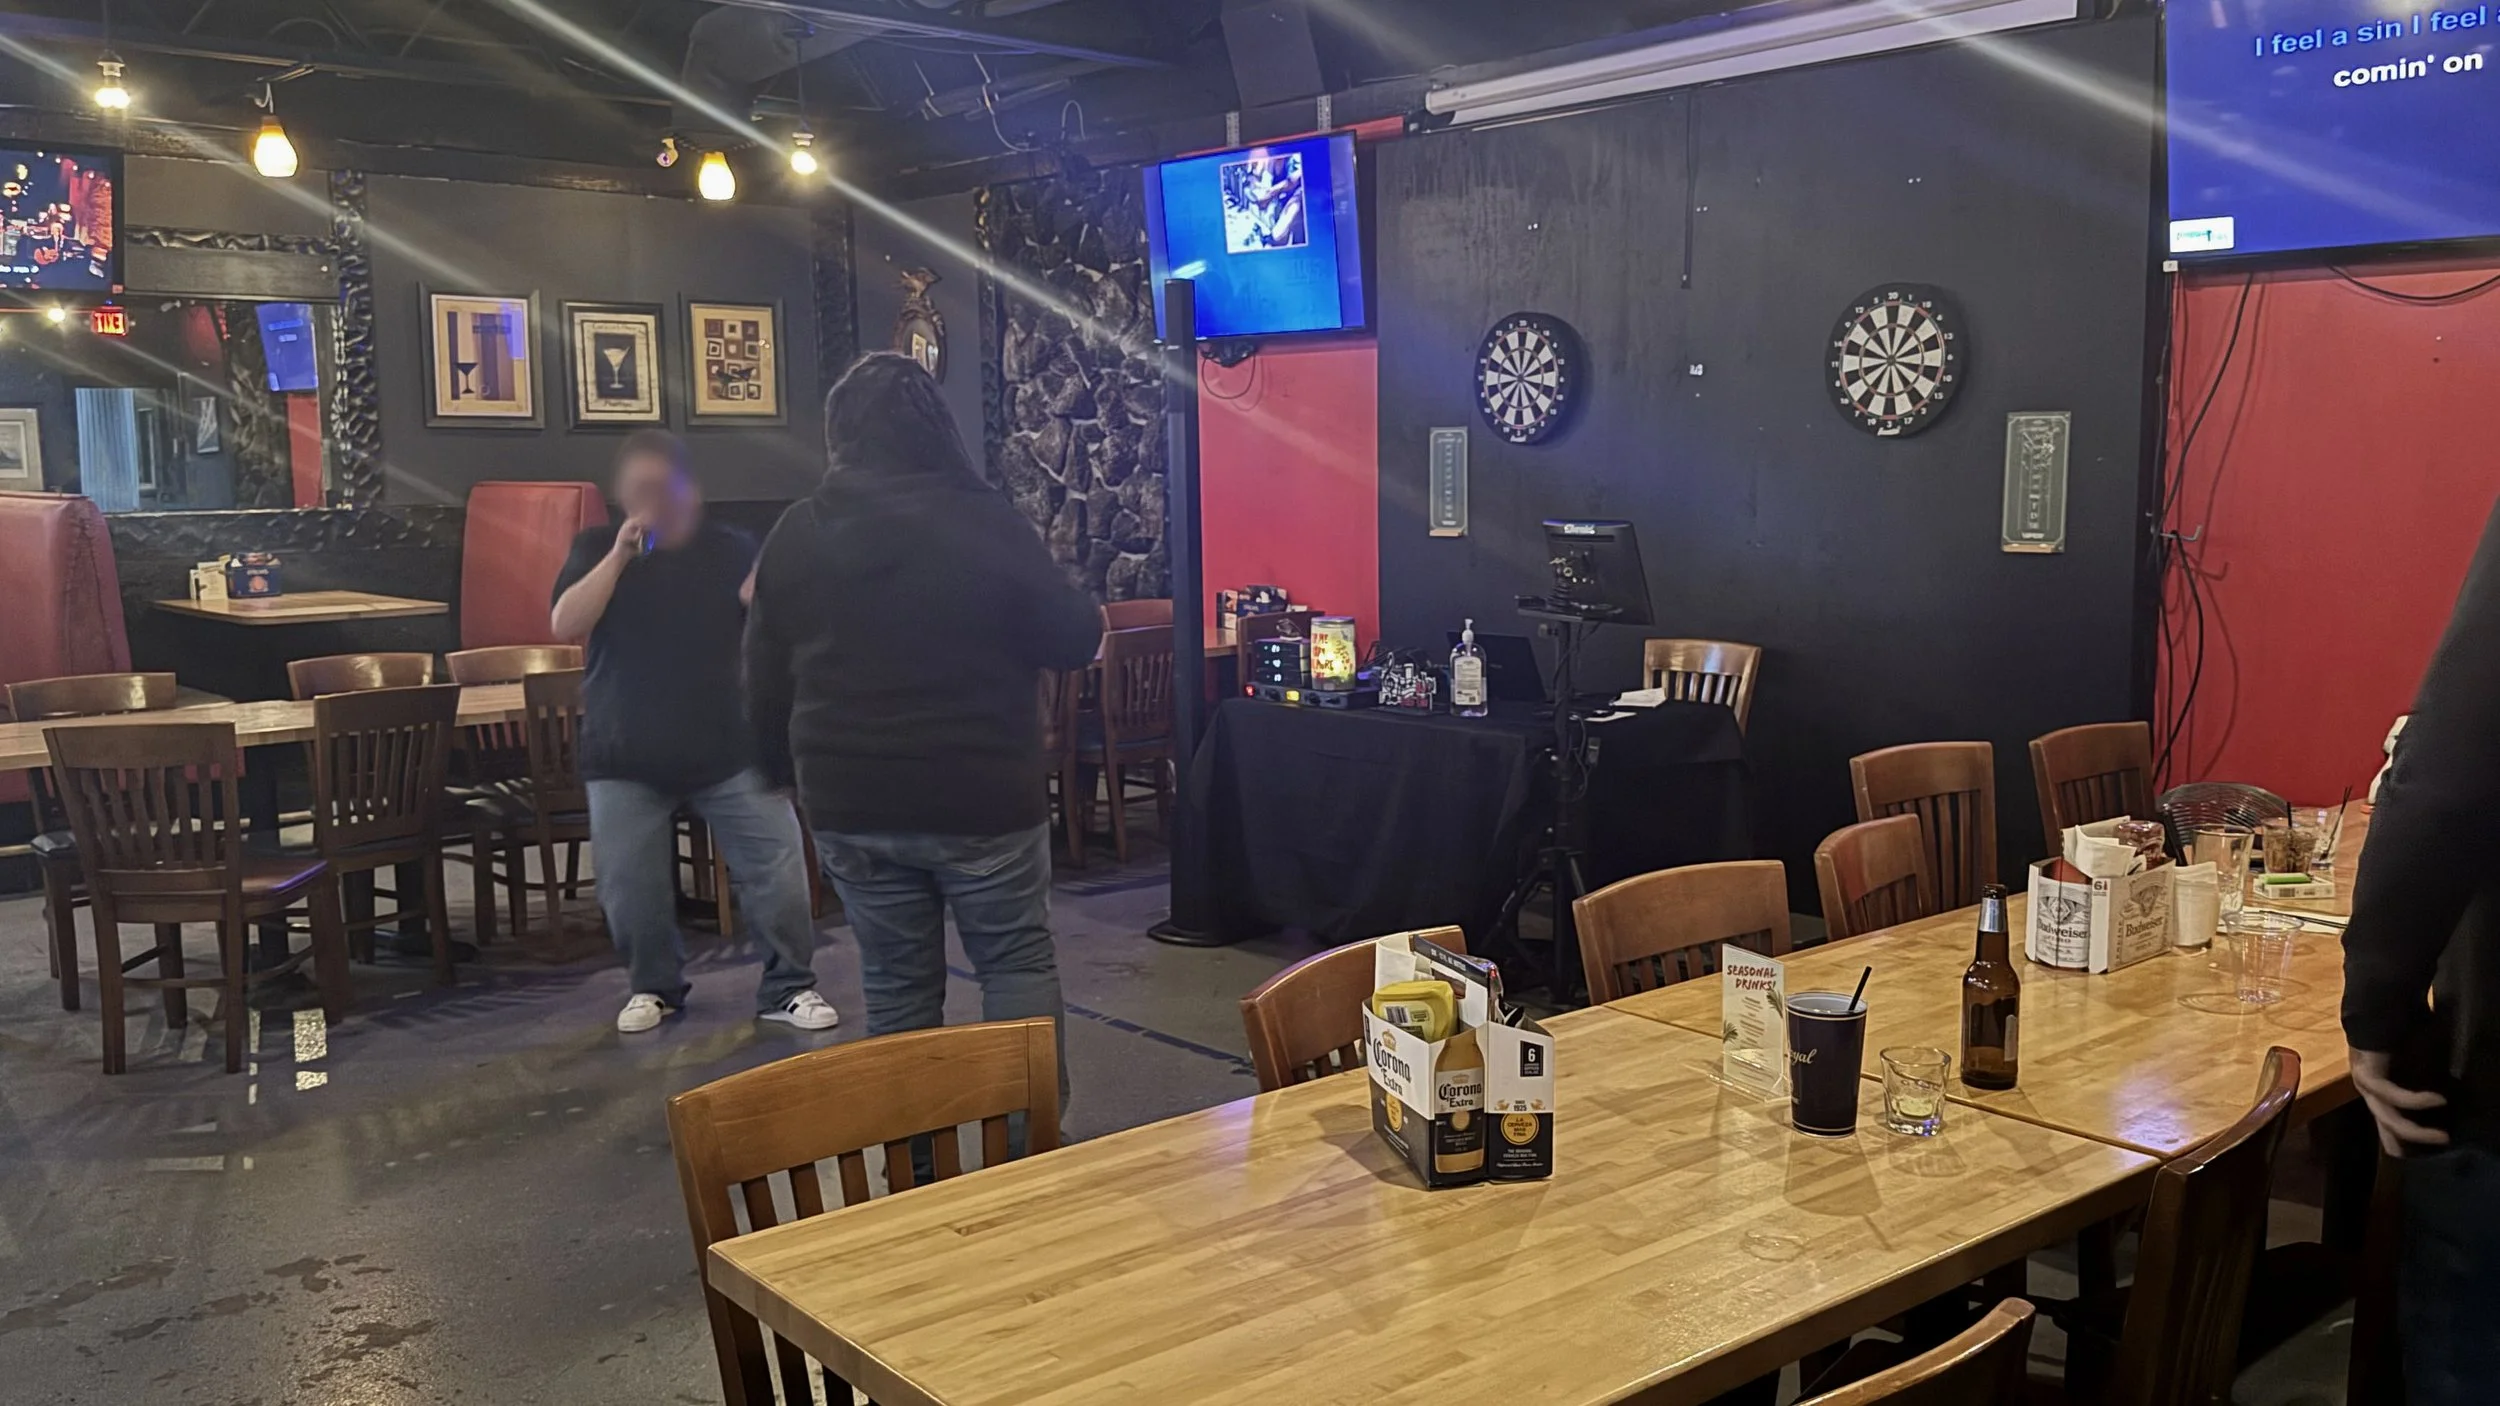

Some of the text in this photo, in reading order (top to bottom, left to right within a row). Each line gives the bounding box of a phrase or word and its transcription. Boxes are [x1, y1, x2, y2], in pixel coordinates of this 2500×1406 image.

[2255, 37, 2262, 57] I
[2271, 29, 2322, 55] feel
[2331, 30, 2348, 46] a
[2357, 20, 2401, 42] sin
[2413, 15, 2419, 35] I
[2430, 5, 2486, 32] feel
[2333, 53, 2483, 87] comin' on
[2093, 881, 2103, 891] 6
[1727, 964, 1777, 978] SEASONAL
[1735, 978, 1777, 991] DRINKS!
[1373, 1038, 1412, 1084] Corona
[1527, 1048, 1536, 1062] 6
[1381, 1068, 1403, 1096] Extra
[1438, 1083, 1482, 1101] Corona
[1447, 1097, 1474, 1108] Extra
